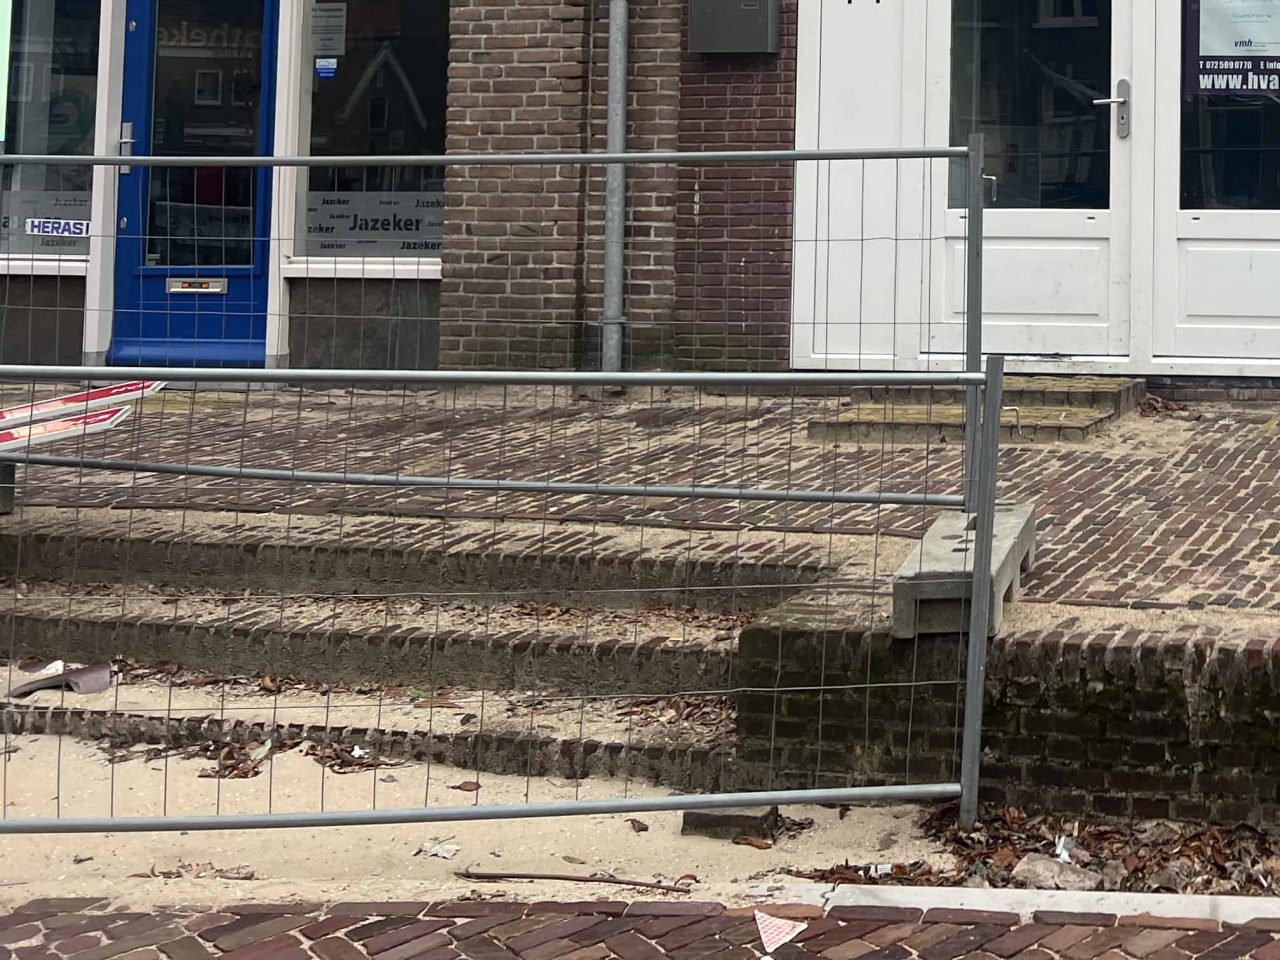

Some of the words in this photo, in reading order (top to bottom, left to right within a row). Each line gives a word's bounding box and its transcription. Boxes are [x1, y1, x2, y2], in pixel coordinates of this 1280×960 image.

[1234, 38, 1253, 47] vmh
[30, 220, 84, 236] HERAS
[349, 213, 423, 232] Jazeker
[400, 241, 442, 250] Jazeker
